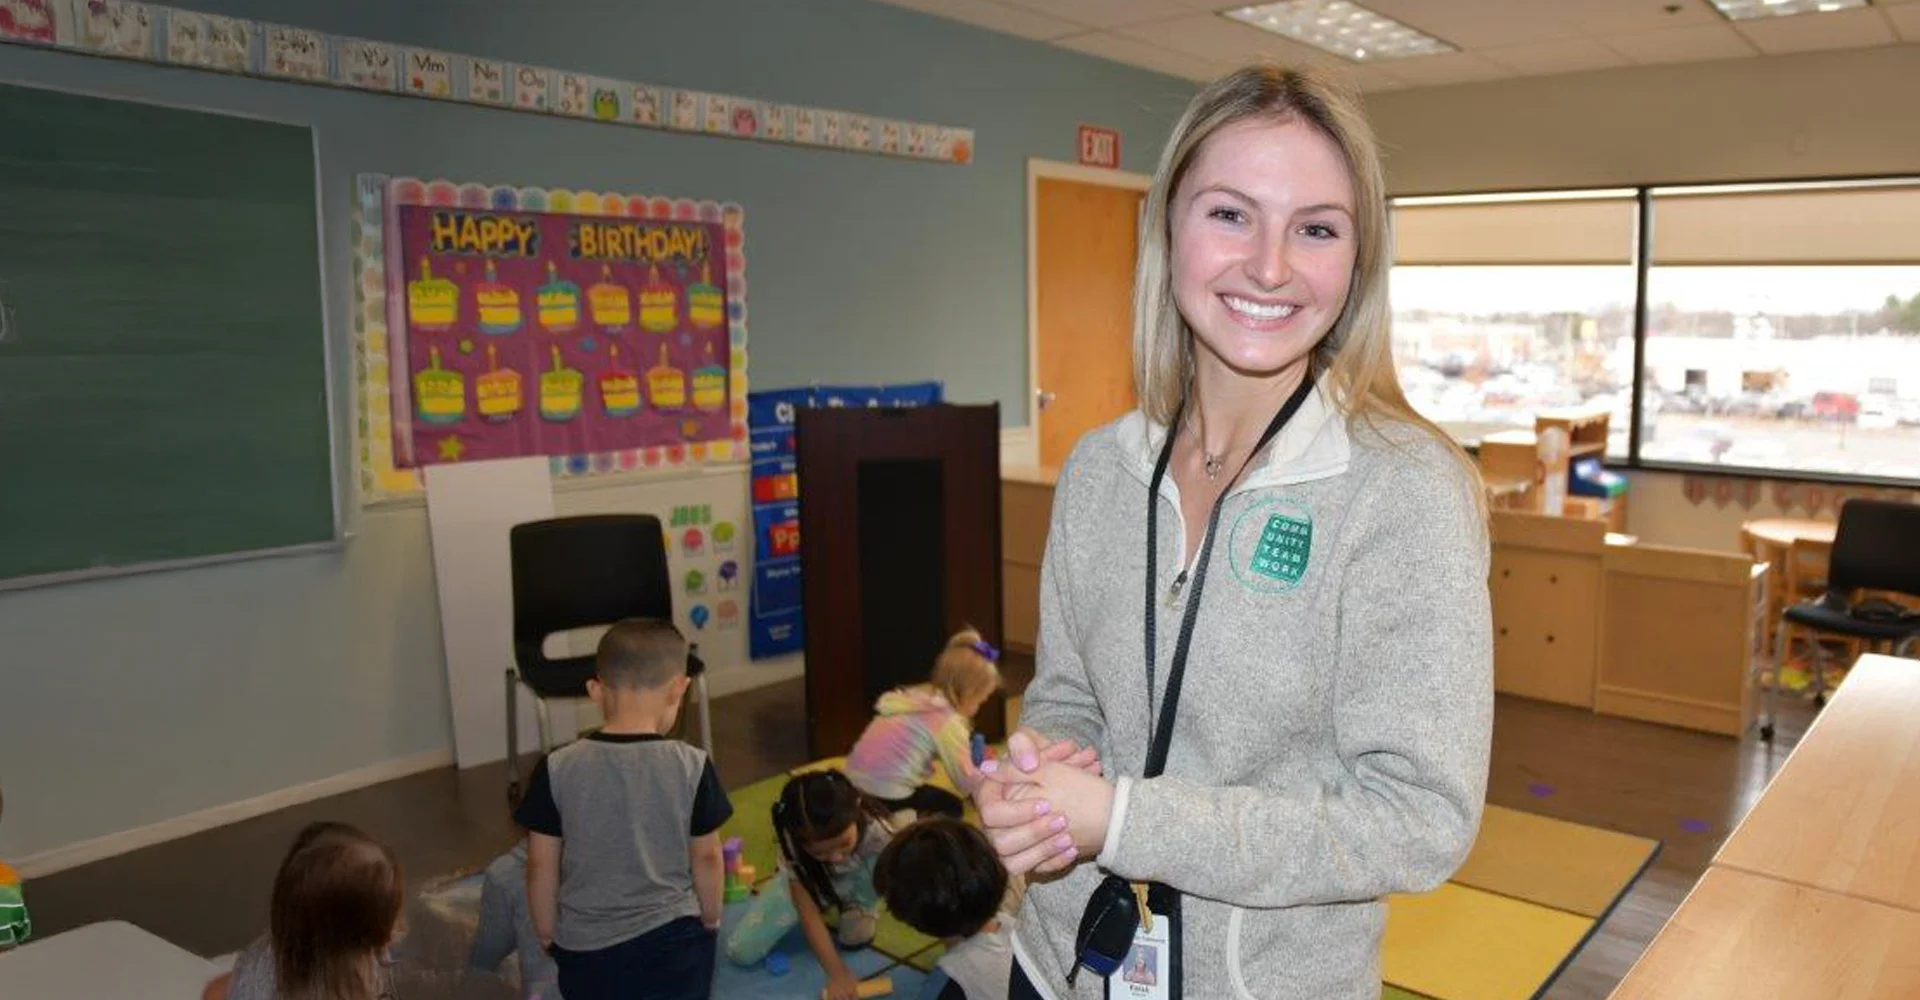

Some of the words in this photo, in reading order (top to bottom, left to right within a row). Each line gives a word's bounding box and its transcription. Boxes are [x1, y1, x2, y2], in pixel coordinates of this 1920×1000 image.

[1082, 130, 1114, 164] EXIT
[431, 214, 534, 256] HAPPY
[579, 223, 705, 261] BIRTHDAY!
[1261, 543, 1302, 563] TEAM
[1259, 557, 1299, 577] WORK
